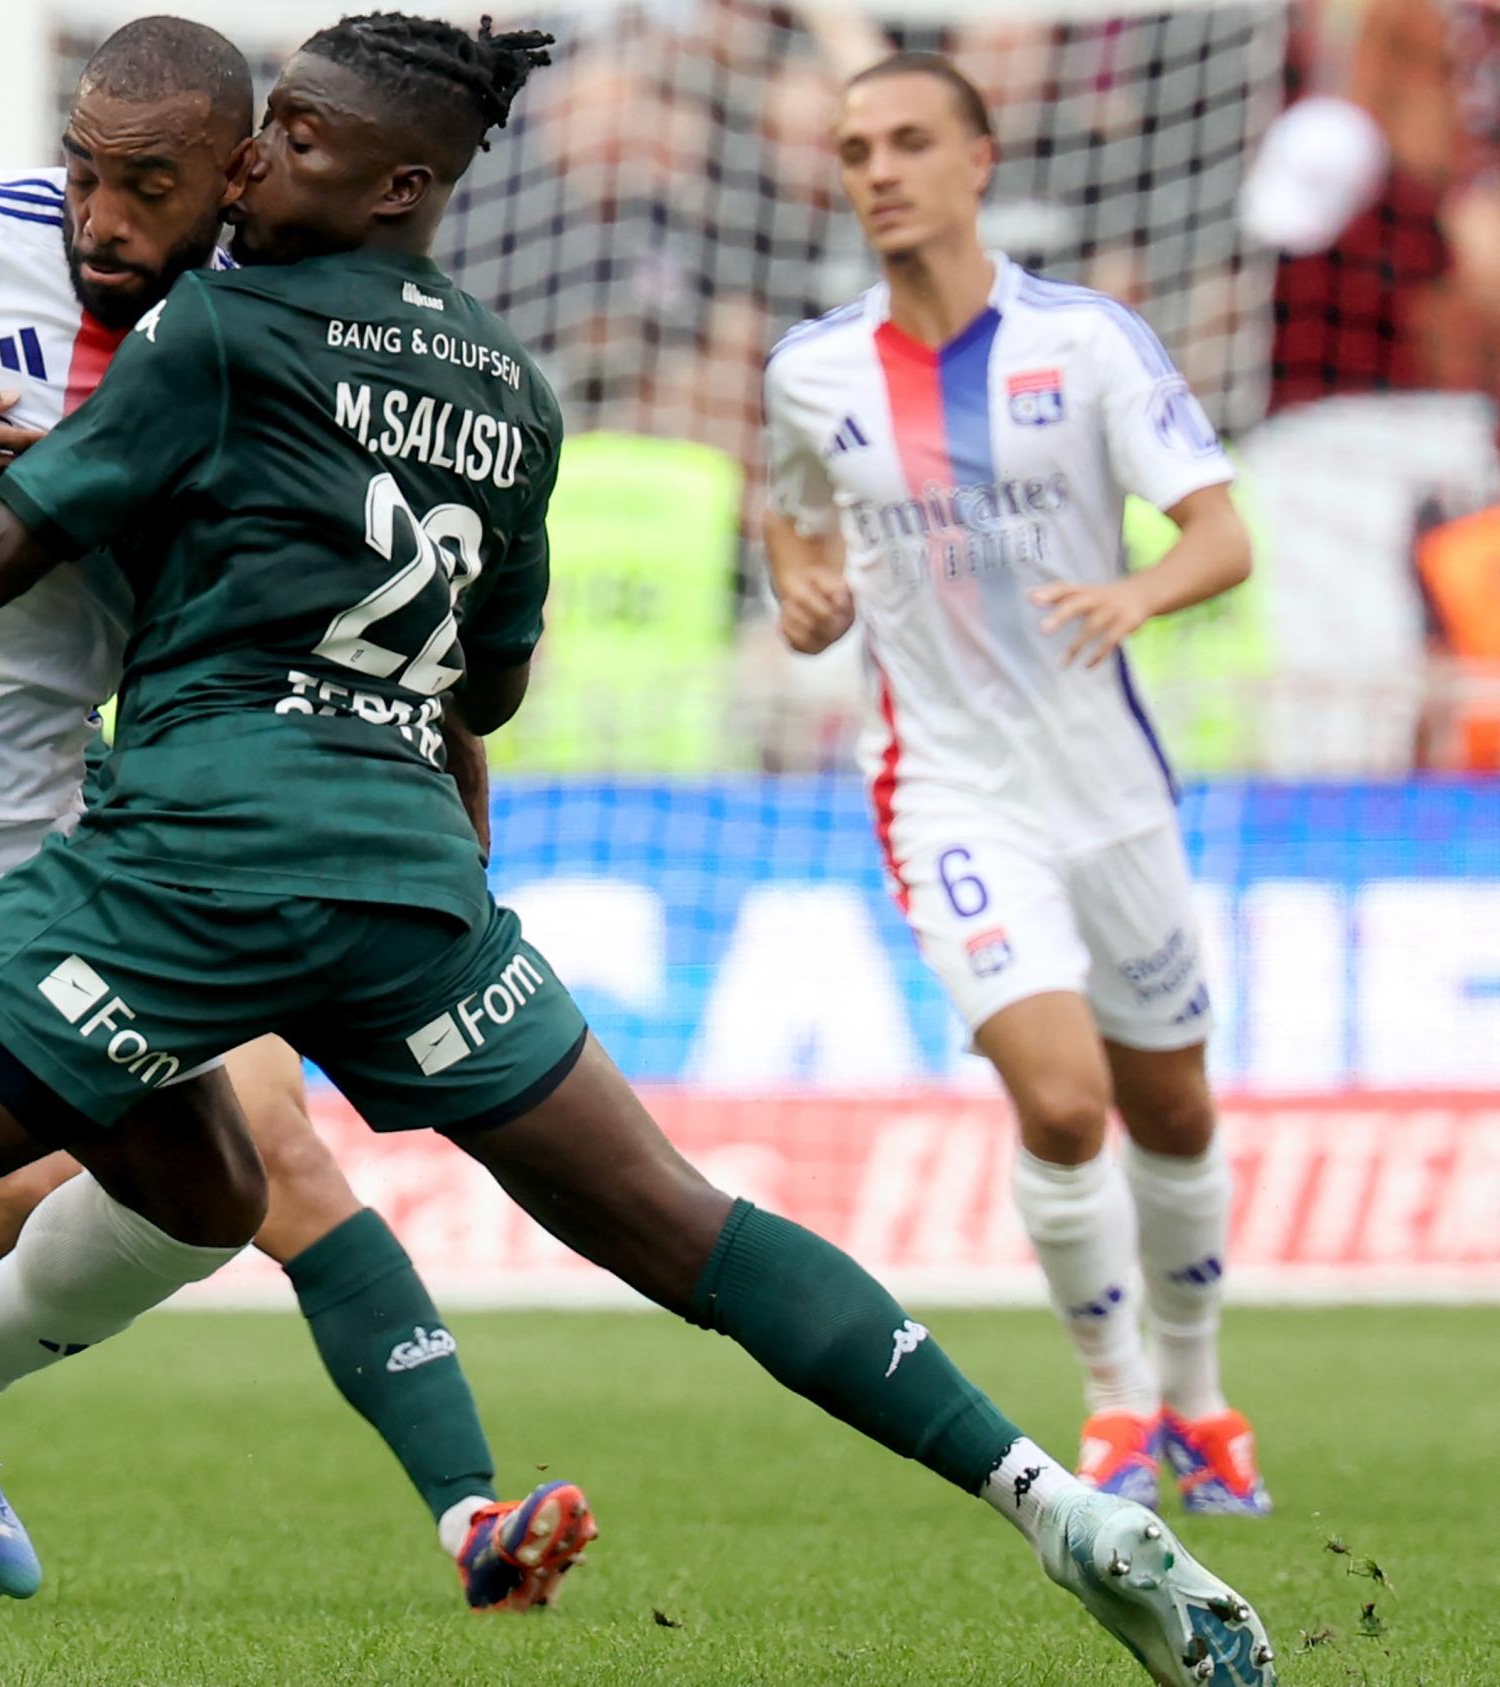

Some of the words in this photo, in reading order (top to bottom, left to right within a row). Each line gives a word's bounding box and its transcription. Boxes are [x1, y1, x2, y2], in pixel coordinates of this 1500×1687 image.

[327, 319, 401, 353] BANG
[411, 328, 428, 354] &
[432, 333, 520, 390] OLUFSEN
[334, 381, 522, 488] M.SALISU
[850, 473, 1068, 546] Emirates
[311, 472, 483, 696] 22
[939, 848, 988, 918] 6
[79, 995, 181, 1089] Fom
[457, 953, 544, 1046] Fom
